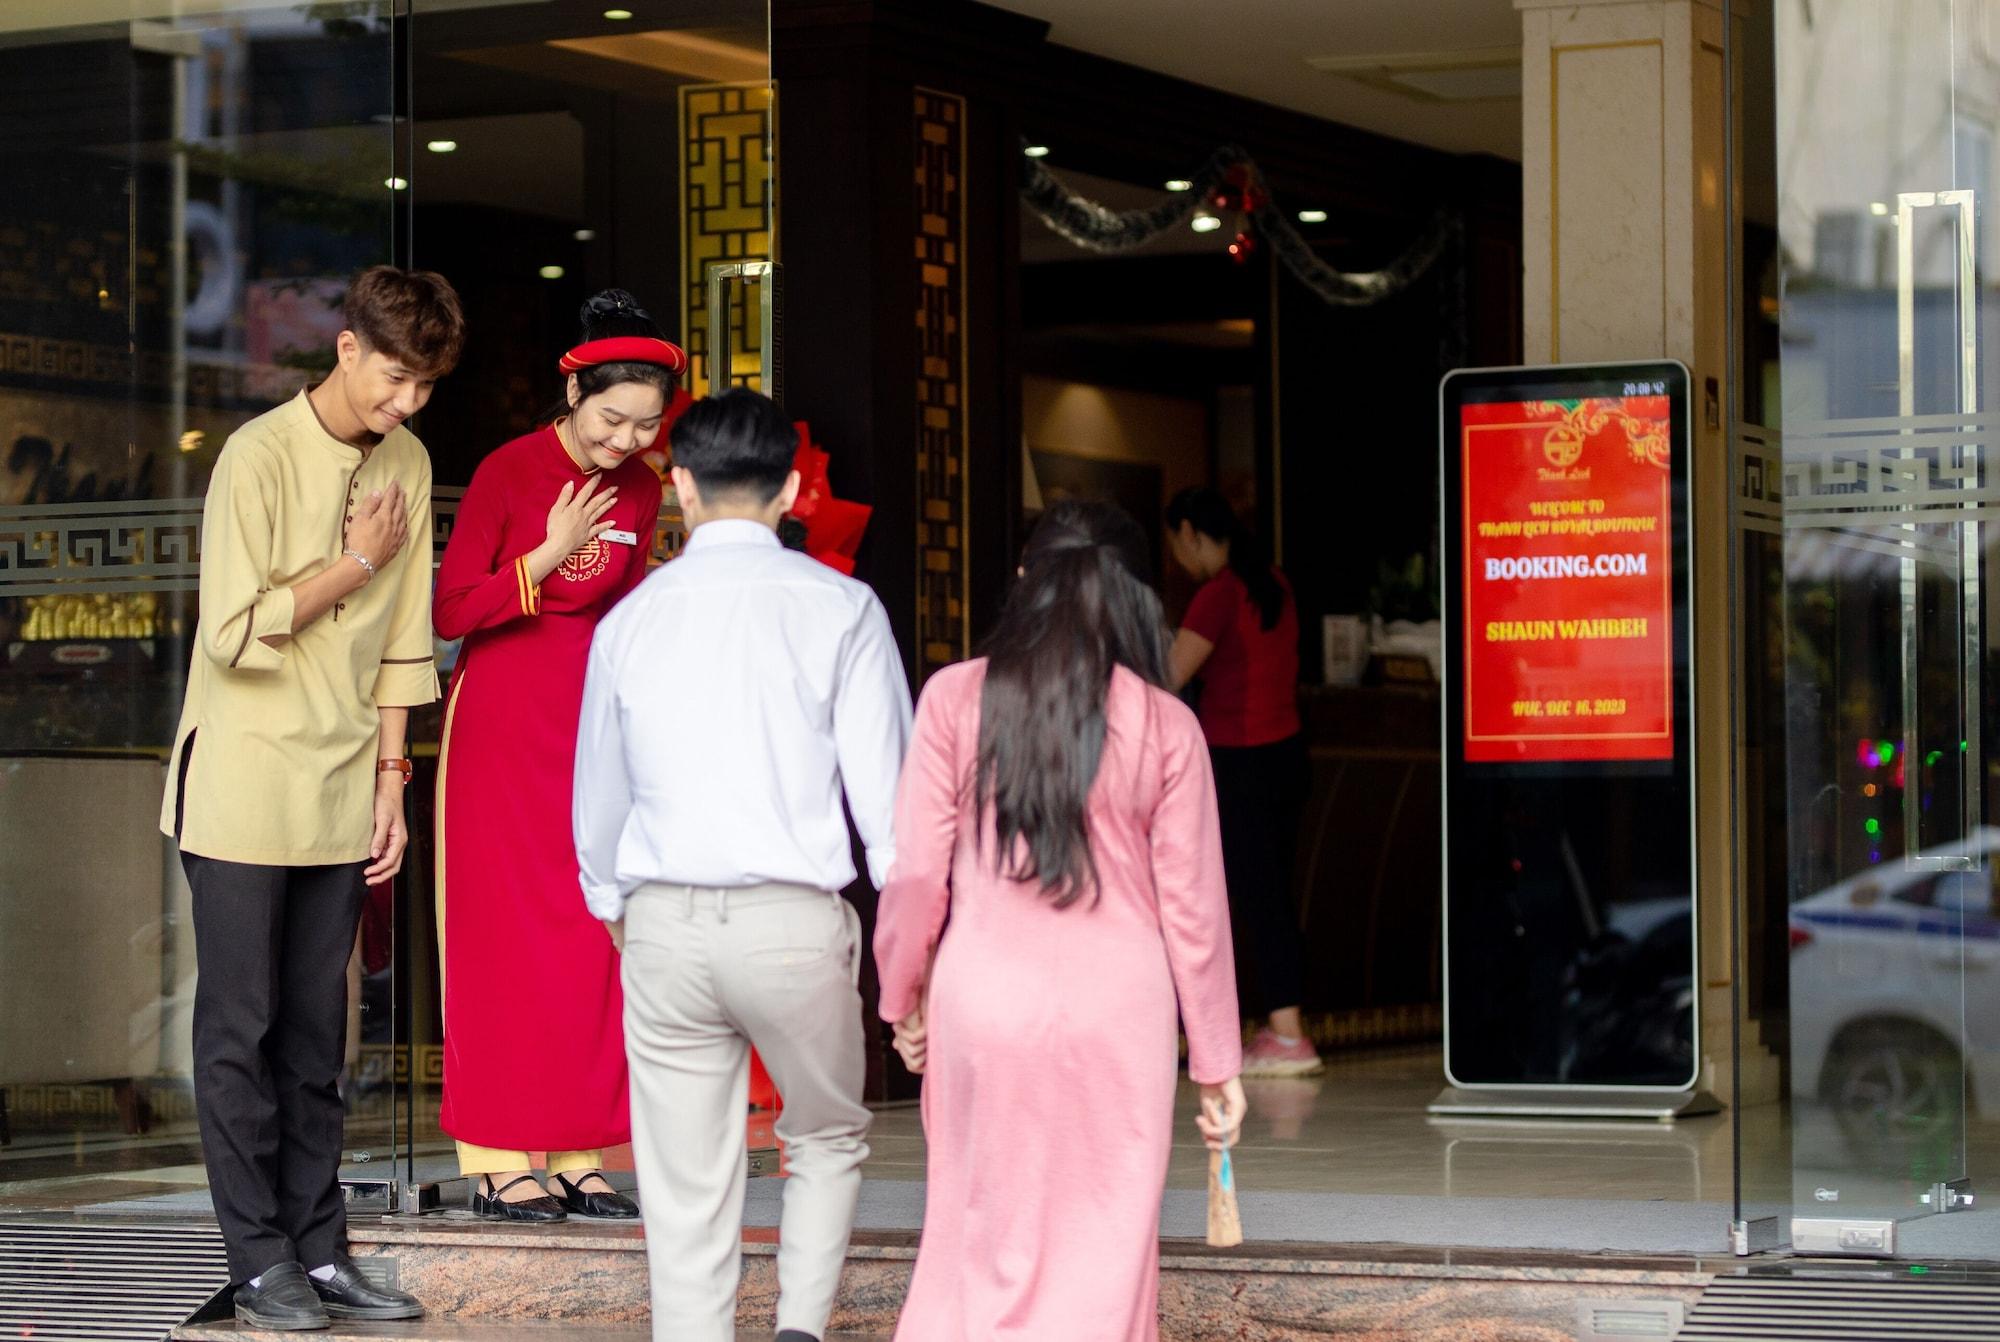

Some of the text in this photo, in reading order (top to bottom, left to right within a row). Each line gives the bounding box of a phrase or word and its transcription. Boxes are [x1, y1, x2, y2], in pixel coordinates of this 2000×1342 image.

[1529, 499, 1605, 518] WELCOME TO
[1551, 518, 1594, 536] ROYAL
[1593, 516, 1657, 534] BOUTIQUE
[1485, 553, 1647, 581] BOOKING.COM
[1486, 618, 1648, 642] SHAUN WAHBEH
[1546, 700, 1572, 716] DEC
